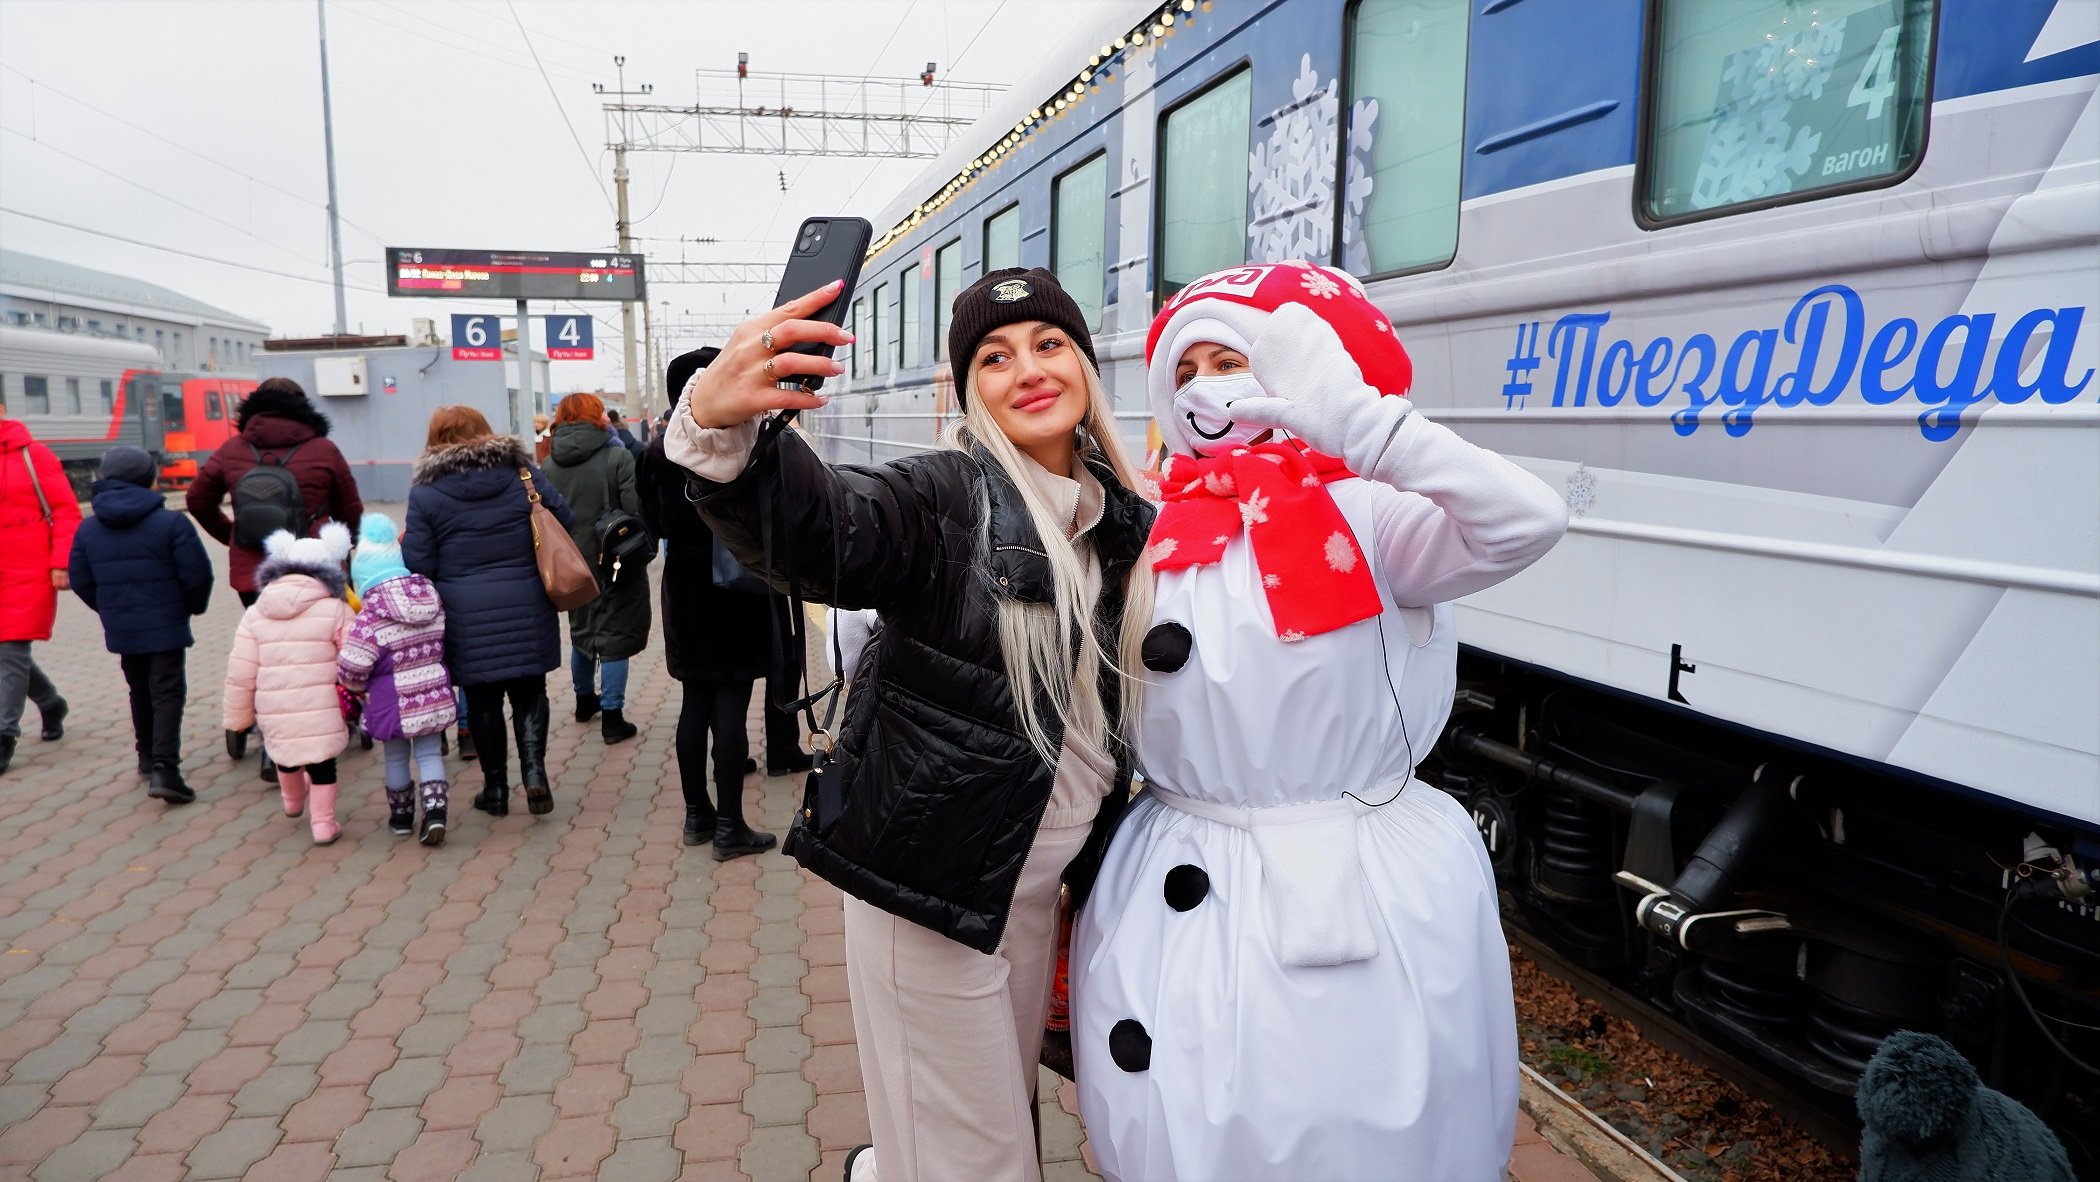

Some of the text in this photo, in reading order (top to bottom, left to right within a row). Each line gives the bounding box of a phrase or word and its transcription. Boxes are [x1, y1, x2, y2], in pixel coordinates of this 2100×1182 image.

[1847, 25, 1901, 120] 4
[1821, 143, 1889, 177] вагон
[412, 251, 423, 263] 6
[465, 317, 487, 347] 6
[558, 318, 581, 347] 4
[1502, 284, 2100, 442] #ПоездДеда
